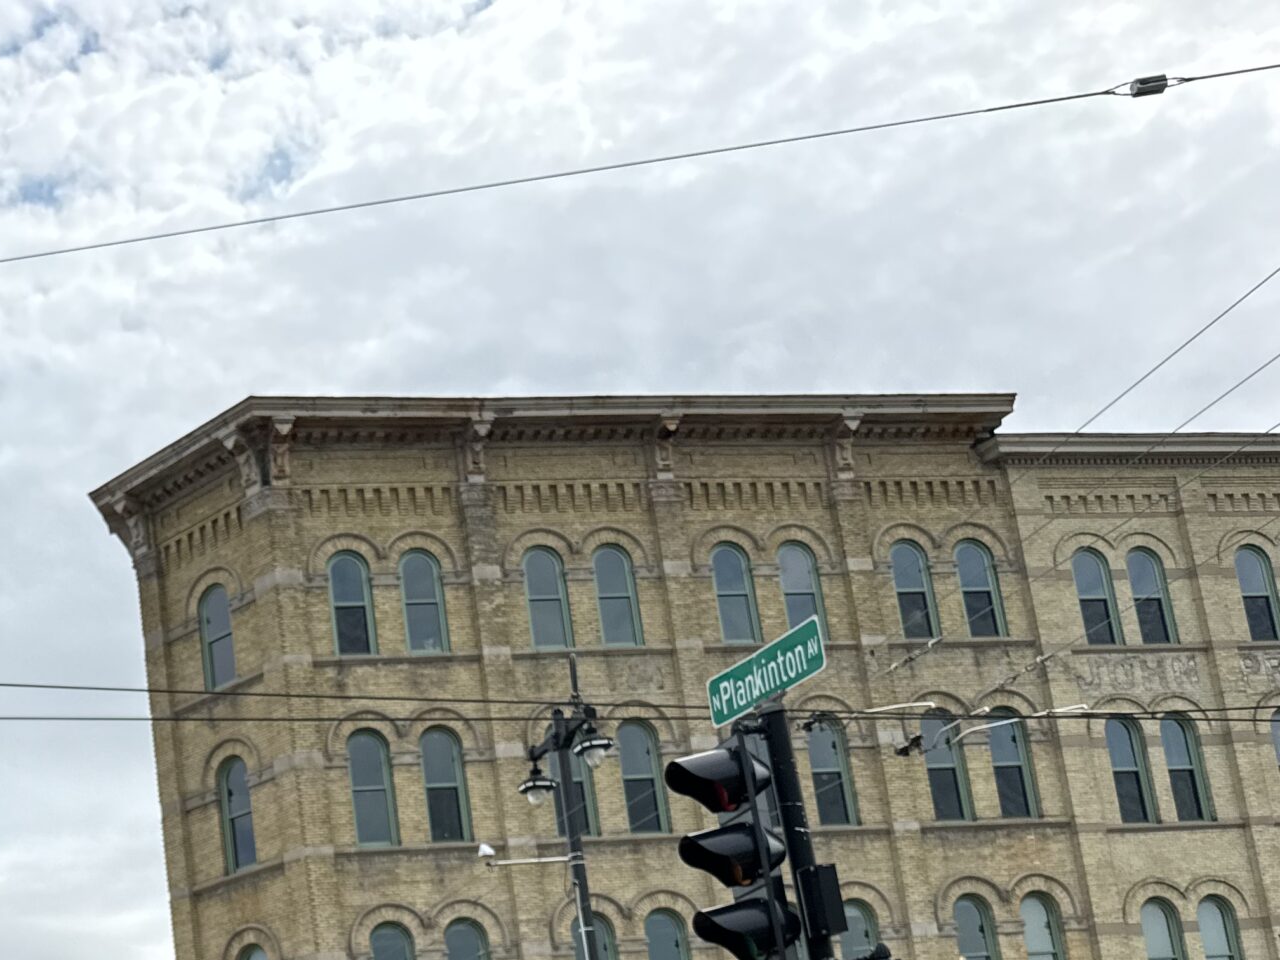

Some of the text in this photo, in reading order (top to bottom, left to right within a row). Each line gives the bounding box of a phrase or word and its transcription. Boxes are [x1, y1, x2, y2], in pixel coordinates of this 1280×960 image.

[712, 636, 819, 715] N Plankinton AV
